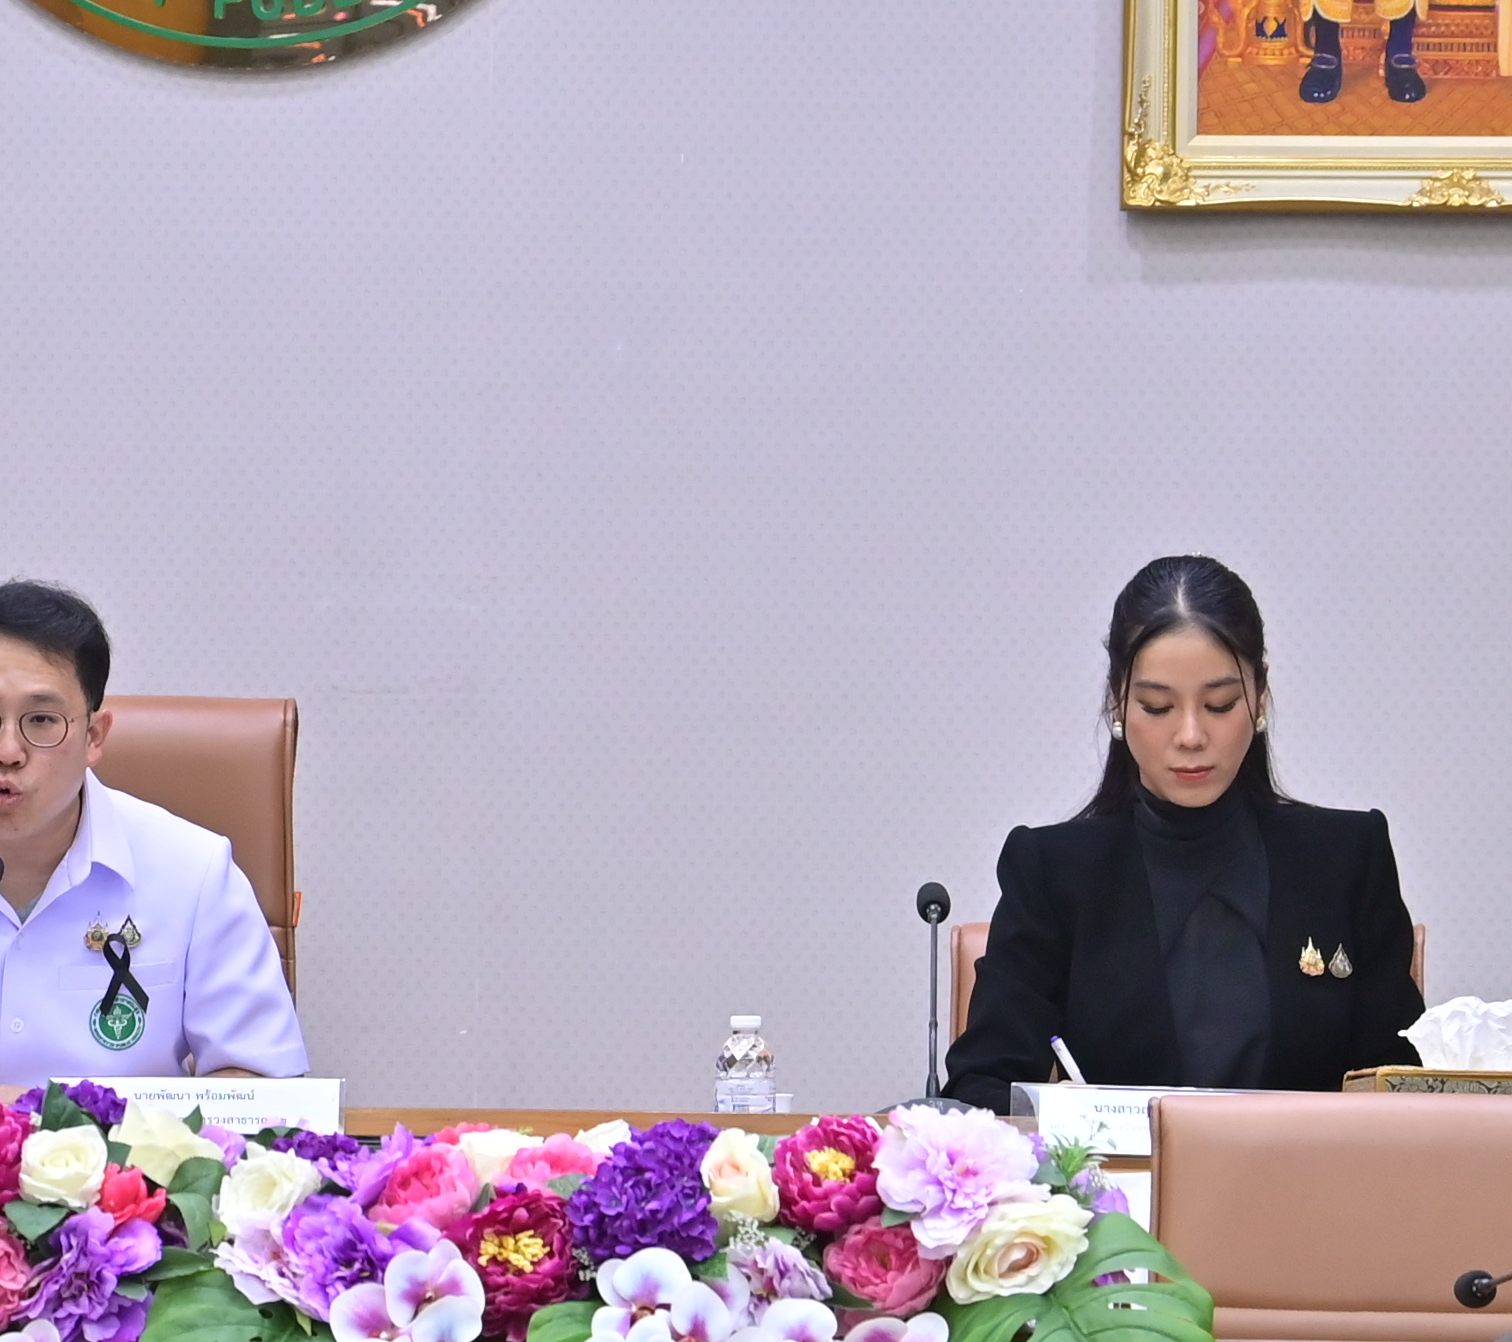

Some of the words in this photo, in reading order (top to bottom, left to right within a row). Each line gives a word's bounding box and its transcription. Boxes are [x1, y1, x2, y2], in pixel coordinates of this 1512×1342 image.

[134, 1089, 191, 1101] นายพัฒนา
[195, 1088, 255, 1101] พร้อมพัฒน์
